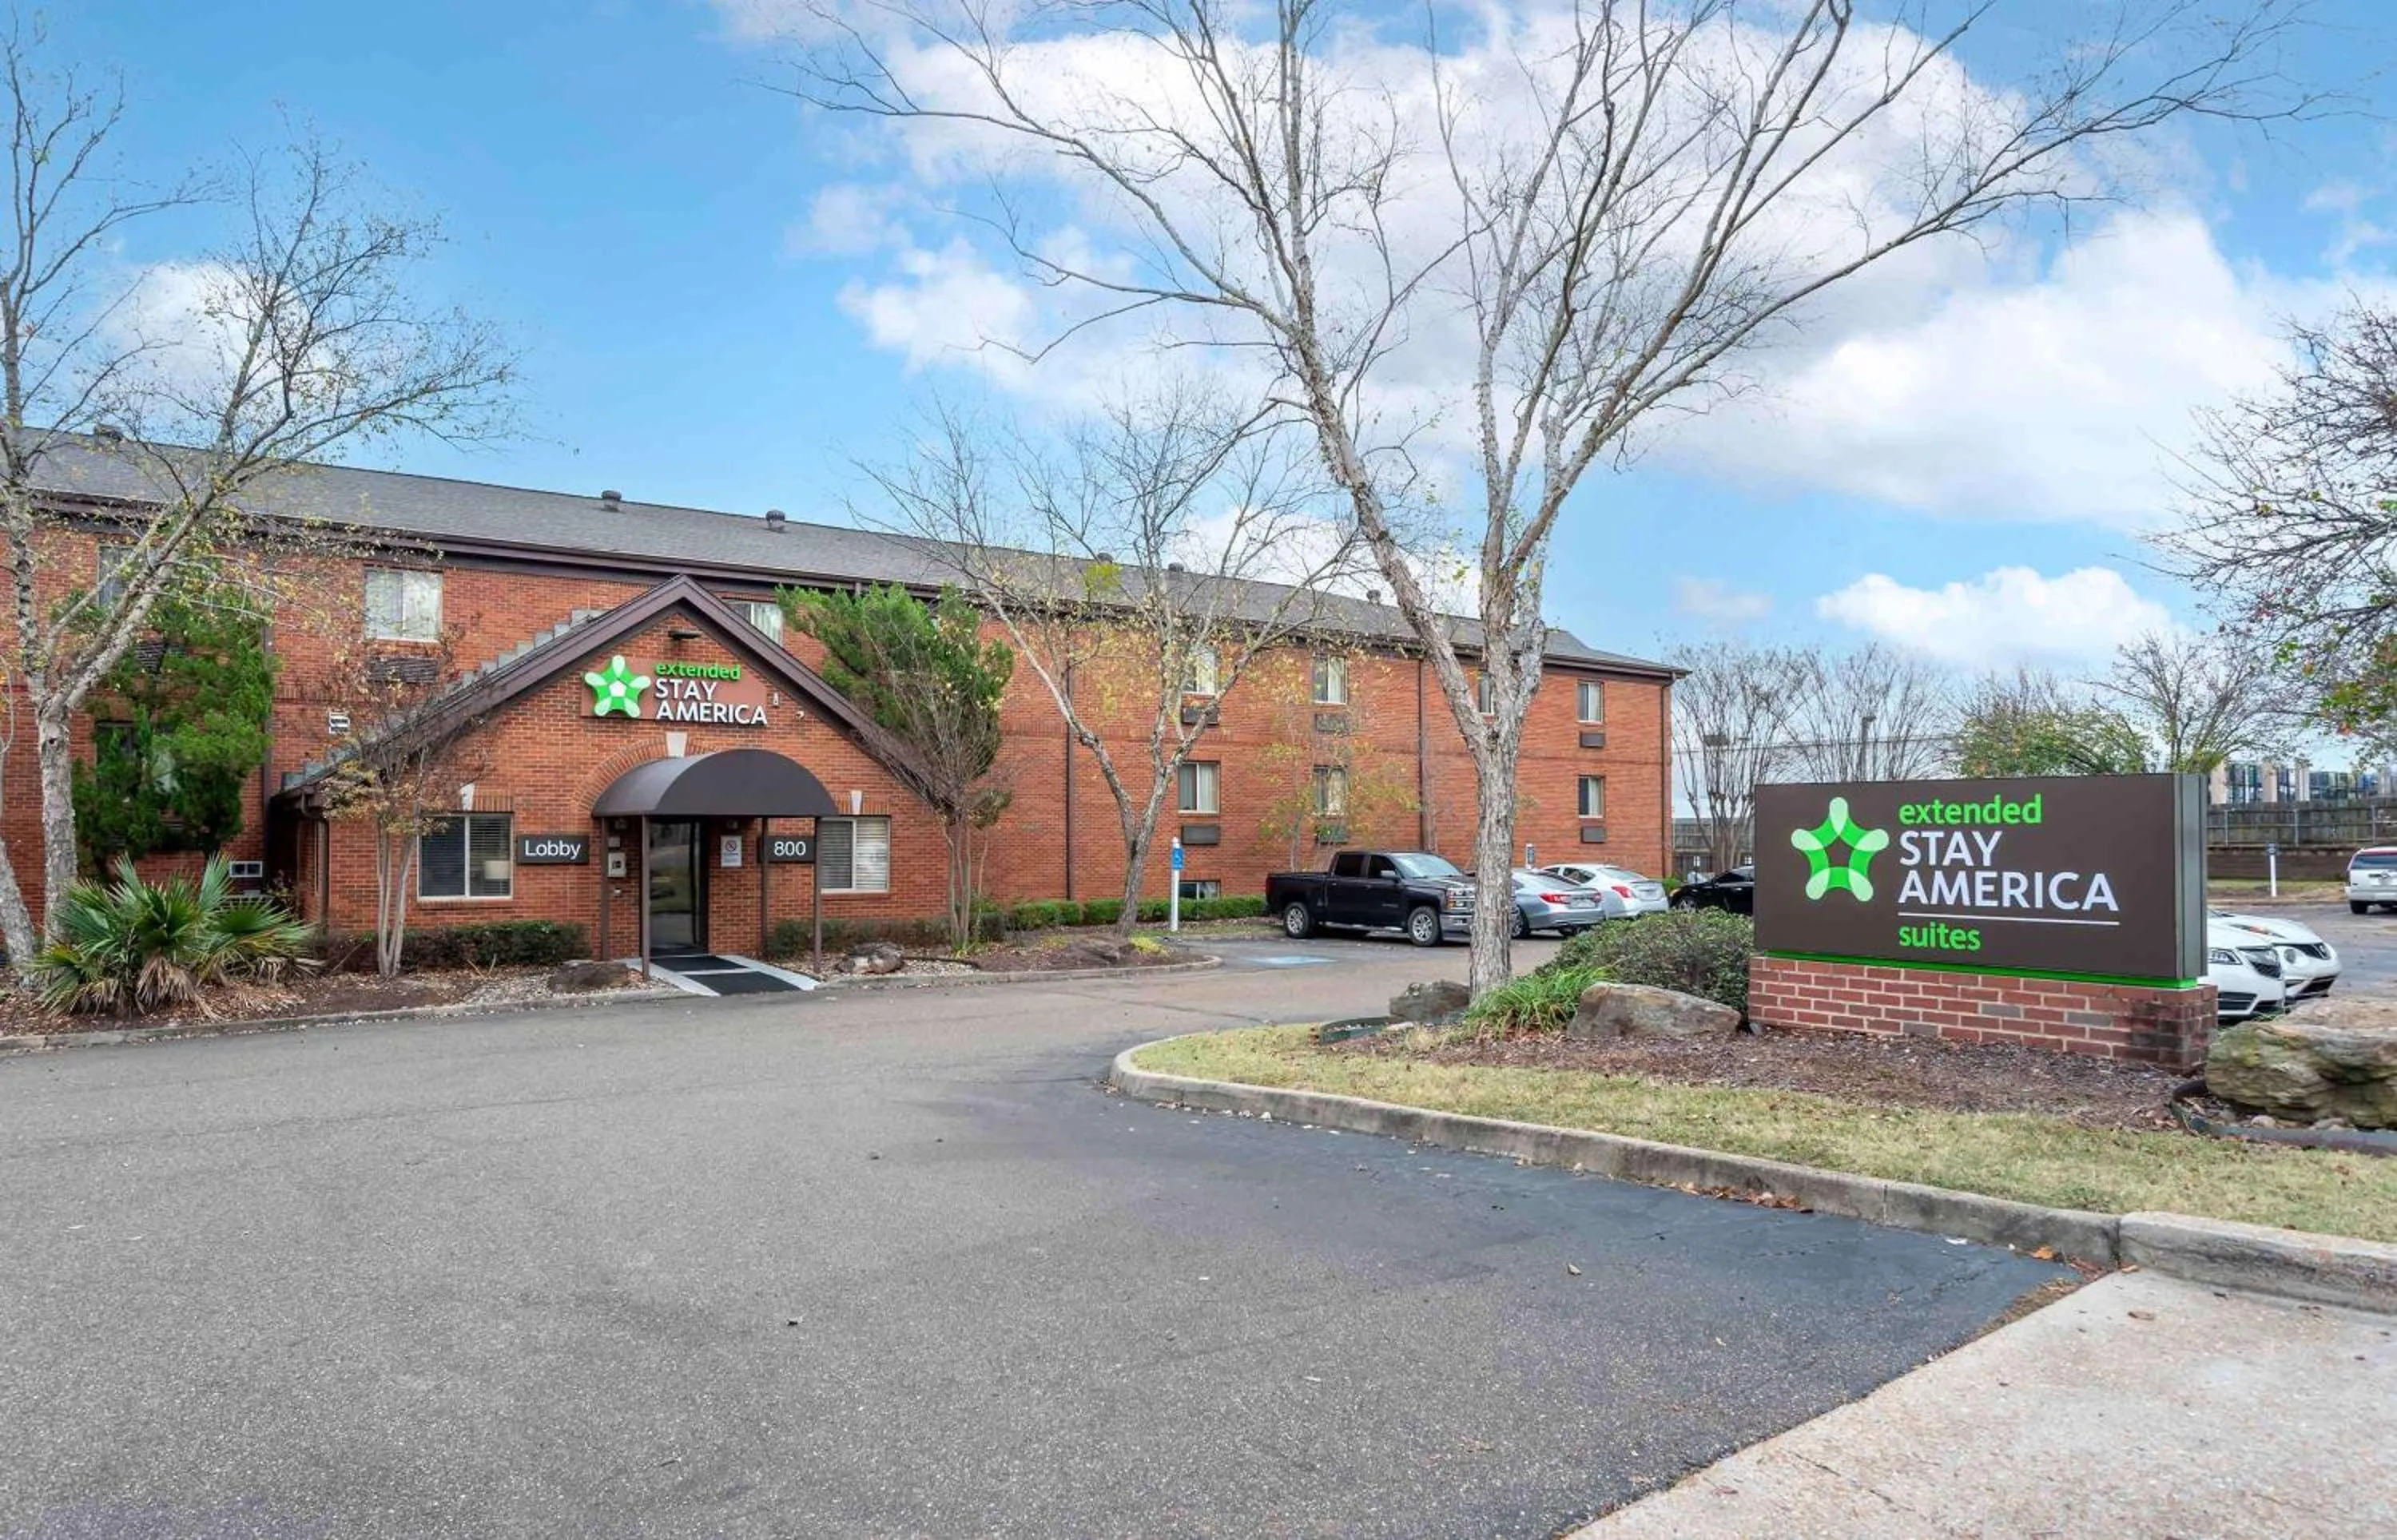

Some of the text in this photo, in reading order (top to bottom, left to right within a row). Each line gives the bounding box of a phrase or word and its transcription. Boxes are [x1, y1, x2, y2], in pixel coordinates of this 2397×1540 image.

[655, 662, 741, 680] extended
[655, 677, 718, 701] STAY
[656, 700, 768, 724] AMERICA
[1899, 794, 2042, 825] extended
[525, 839, 581, 860] Lobby
[774, 841, 806, 856] 800
[1898, 830, 2003, 867] STAY
[1898, 870, 2120, 911] AMERICA
[1898, 921, 1981, 951] suites
